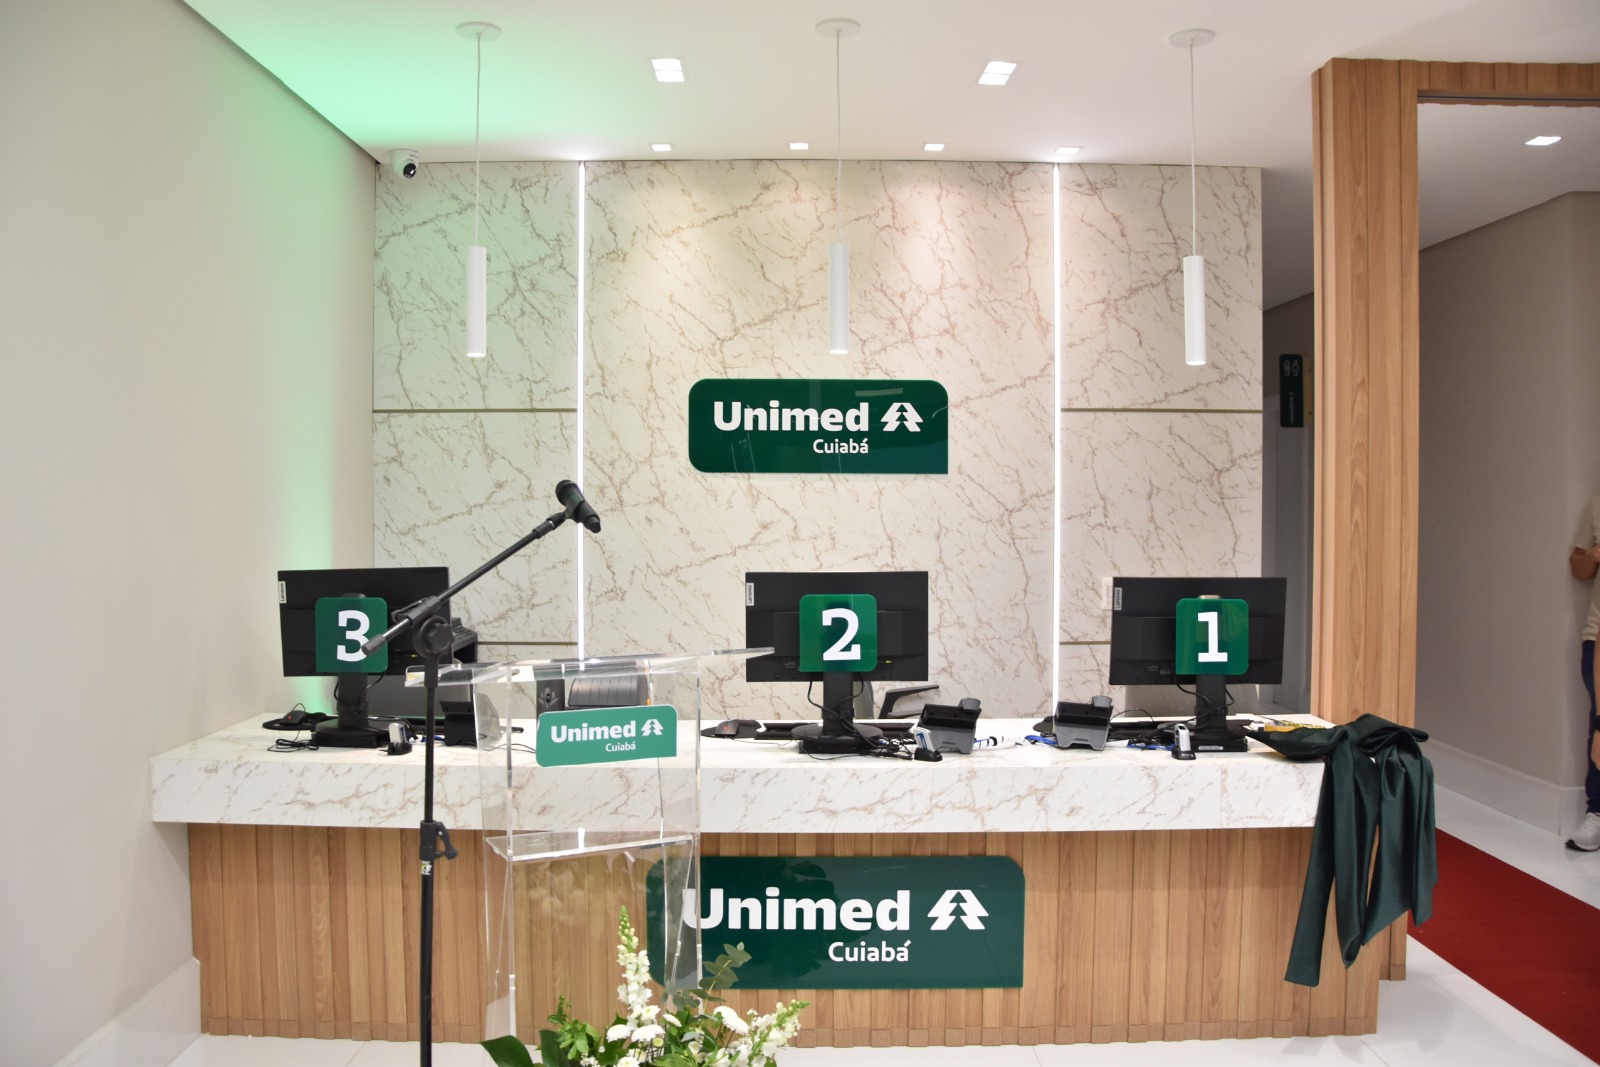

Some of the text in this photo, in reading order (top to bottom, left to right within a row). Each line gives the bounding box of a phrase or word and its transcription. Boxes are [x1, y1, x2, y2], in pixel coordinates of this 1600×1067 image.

[714, 400, 869, 432] Unimed
[813, 438, 869, 454] Cuiabá
[337, 609, 370, 662] 3
[822, 608, 861, 661] 2
[1197, 612, 1228, 662] 1
[551, 720, 636, 743] Unimed
[605, 741, 636, 752] Cuiabá
[682, 887, 910, 931] Unimed
[828, 940, 910, 962] Cuiabá
